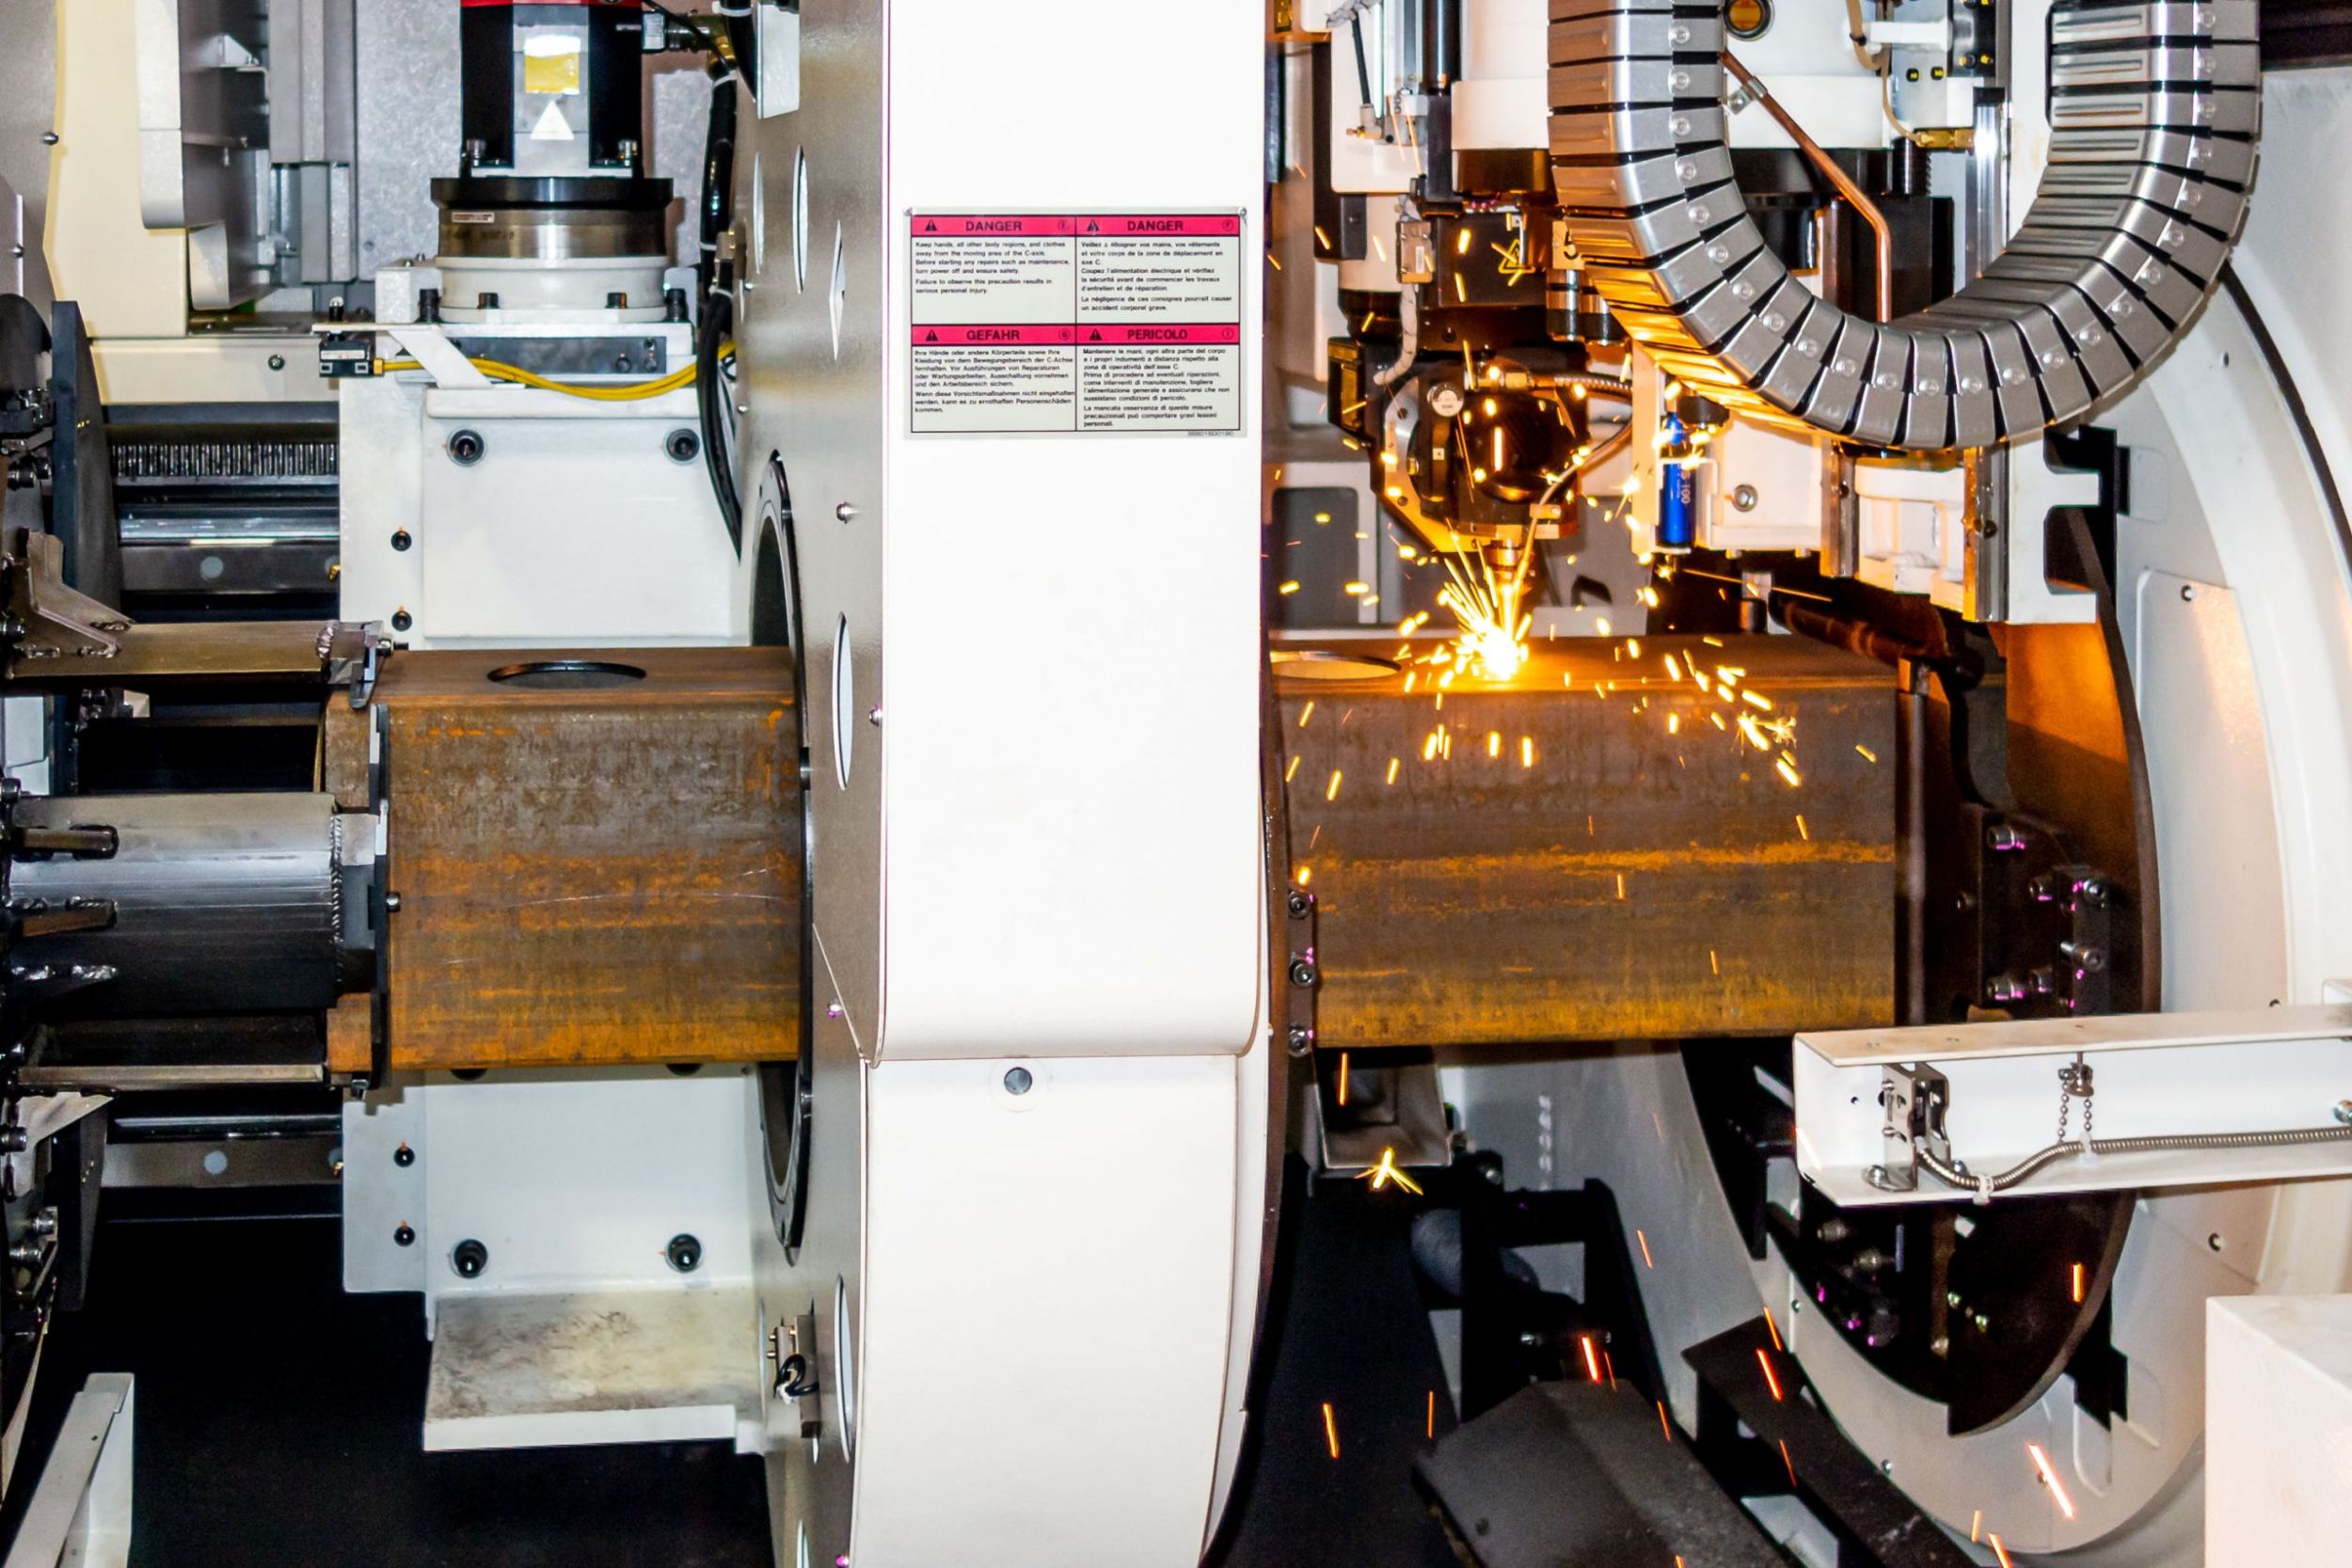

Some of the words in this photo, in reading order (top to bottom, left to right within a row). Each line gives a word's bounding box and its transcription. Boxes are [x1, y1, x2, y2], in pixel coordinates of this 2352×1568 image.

[965, 221, 1023, 231] DANGER
[1127, 220, 1184, 230] DANGER
[966, 330, 1020, 341] GEFAHR
[1127, 329, 1187, 340] PERICOLO
